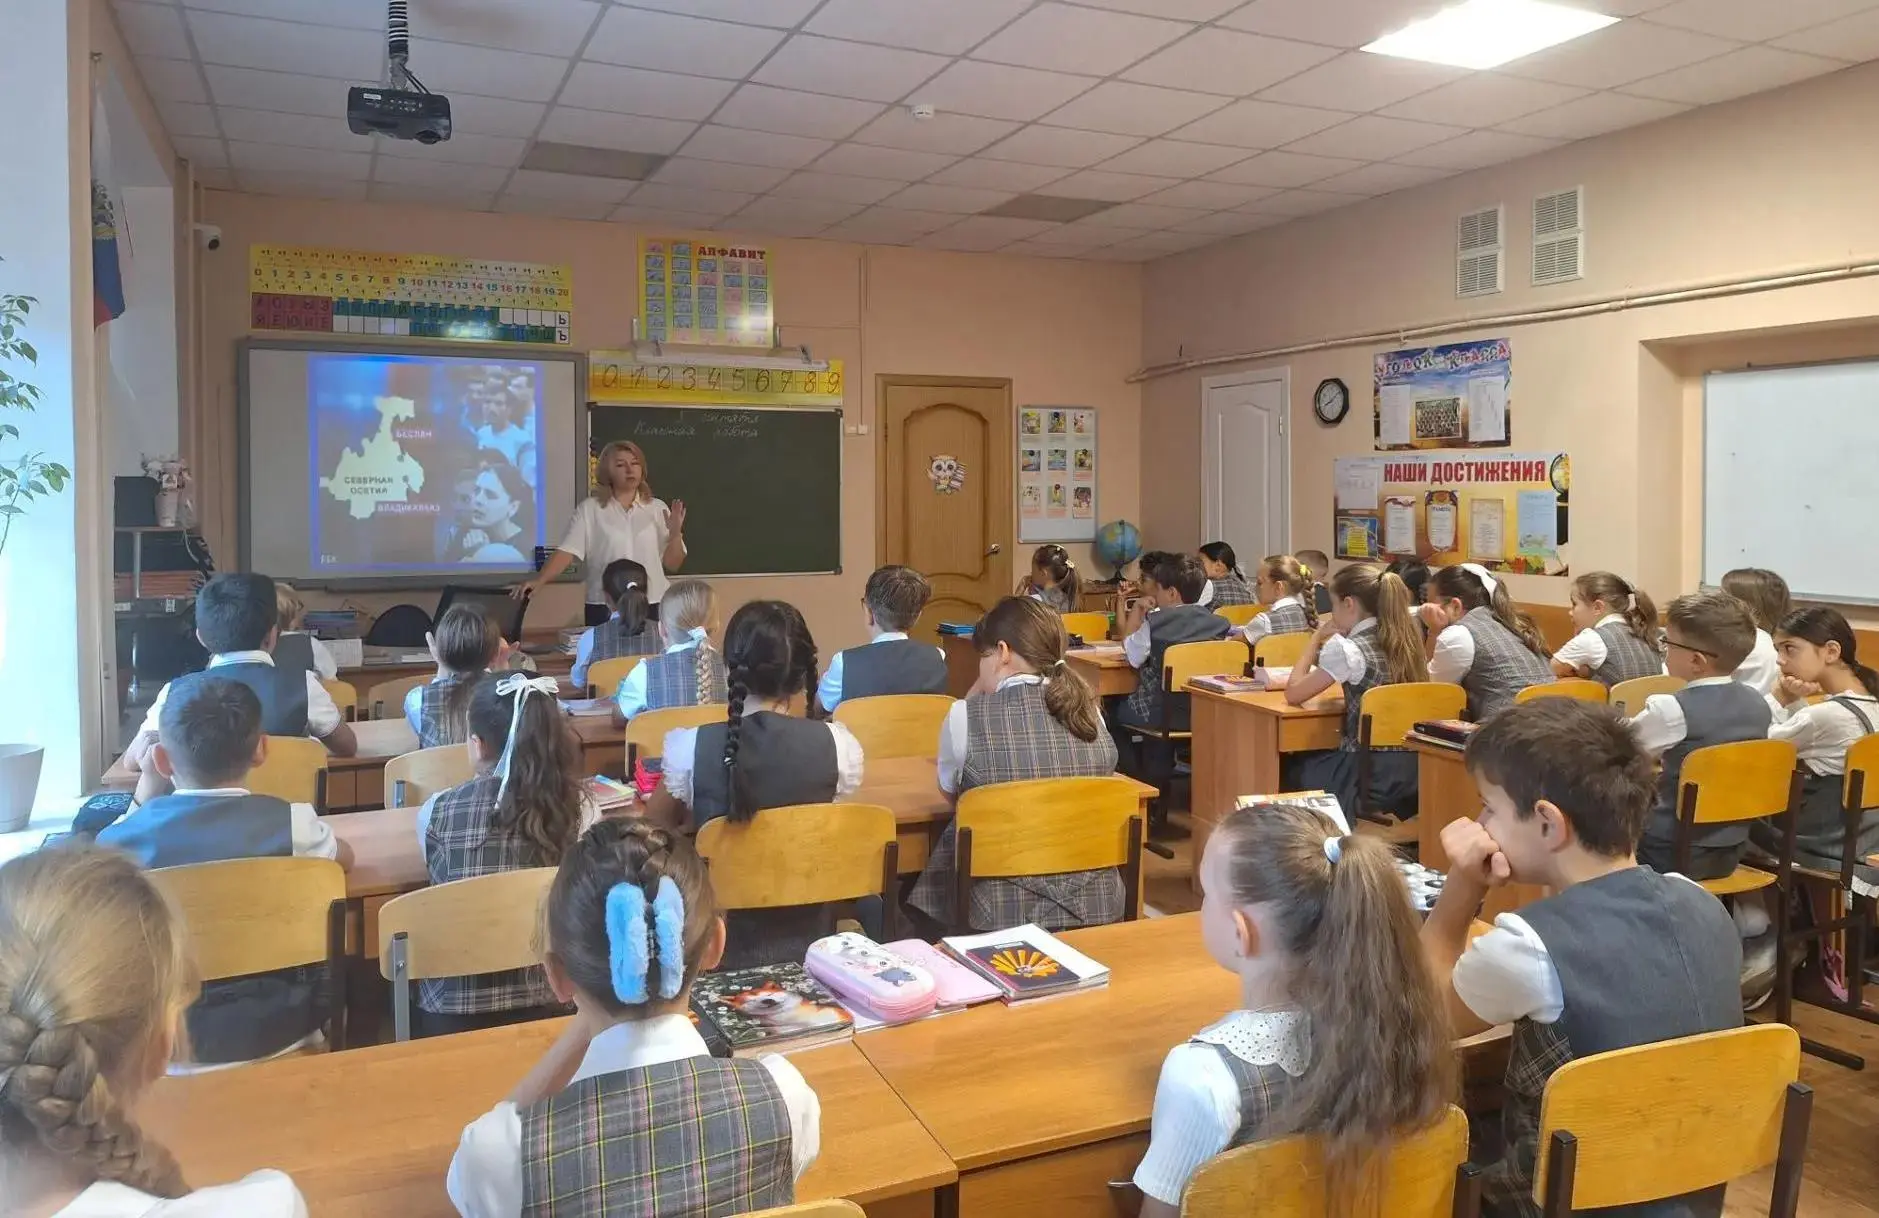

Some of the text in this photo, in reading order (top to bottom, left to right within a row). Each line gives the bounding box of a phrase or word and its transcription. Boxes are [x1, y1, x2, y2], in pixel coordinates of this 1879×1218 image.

[272, 269, 278, 277] 1
[288, 270, 295, 278] 2
[304, 271, 311, 279] 3
[336, 274, 343, 282] 5
[368, 275, 374, 283] 7
[412, 278, 423, 286] 10
[487, 284, 498, 292] 15
[557, 288, 569, 296] 20
[602, 364, 840, 394] 0 1 2 3 4 5 6 7 8 9
[344, 476, 393, 485] СЕВЕРНАЯ
[1384, 463, 1427, 483] НАШИ
[1431, 460, 1546, 485] ДОСТИЖЕНИЯ
[350, 487, 388, 495] ОСЕТИЯ
